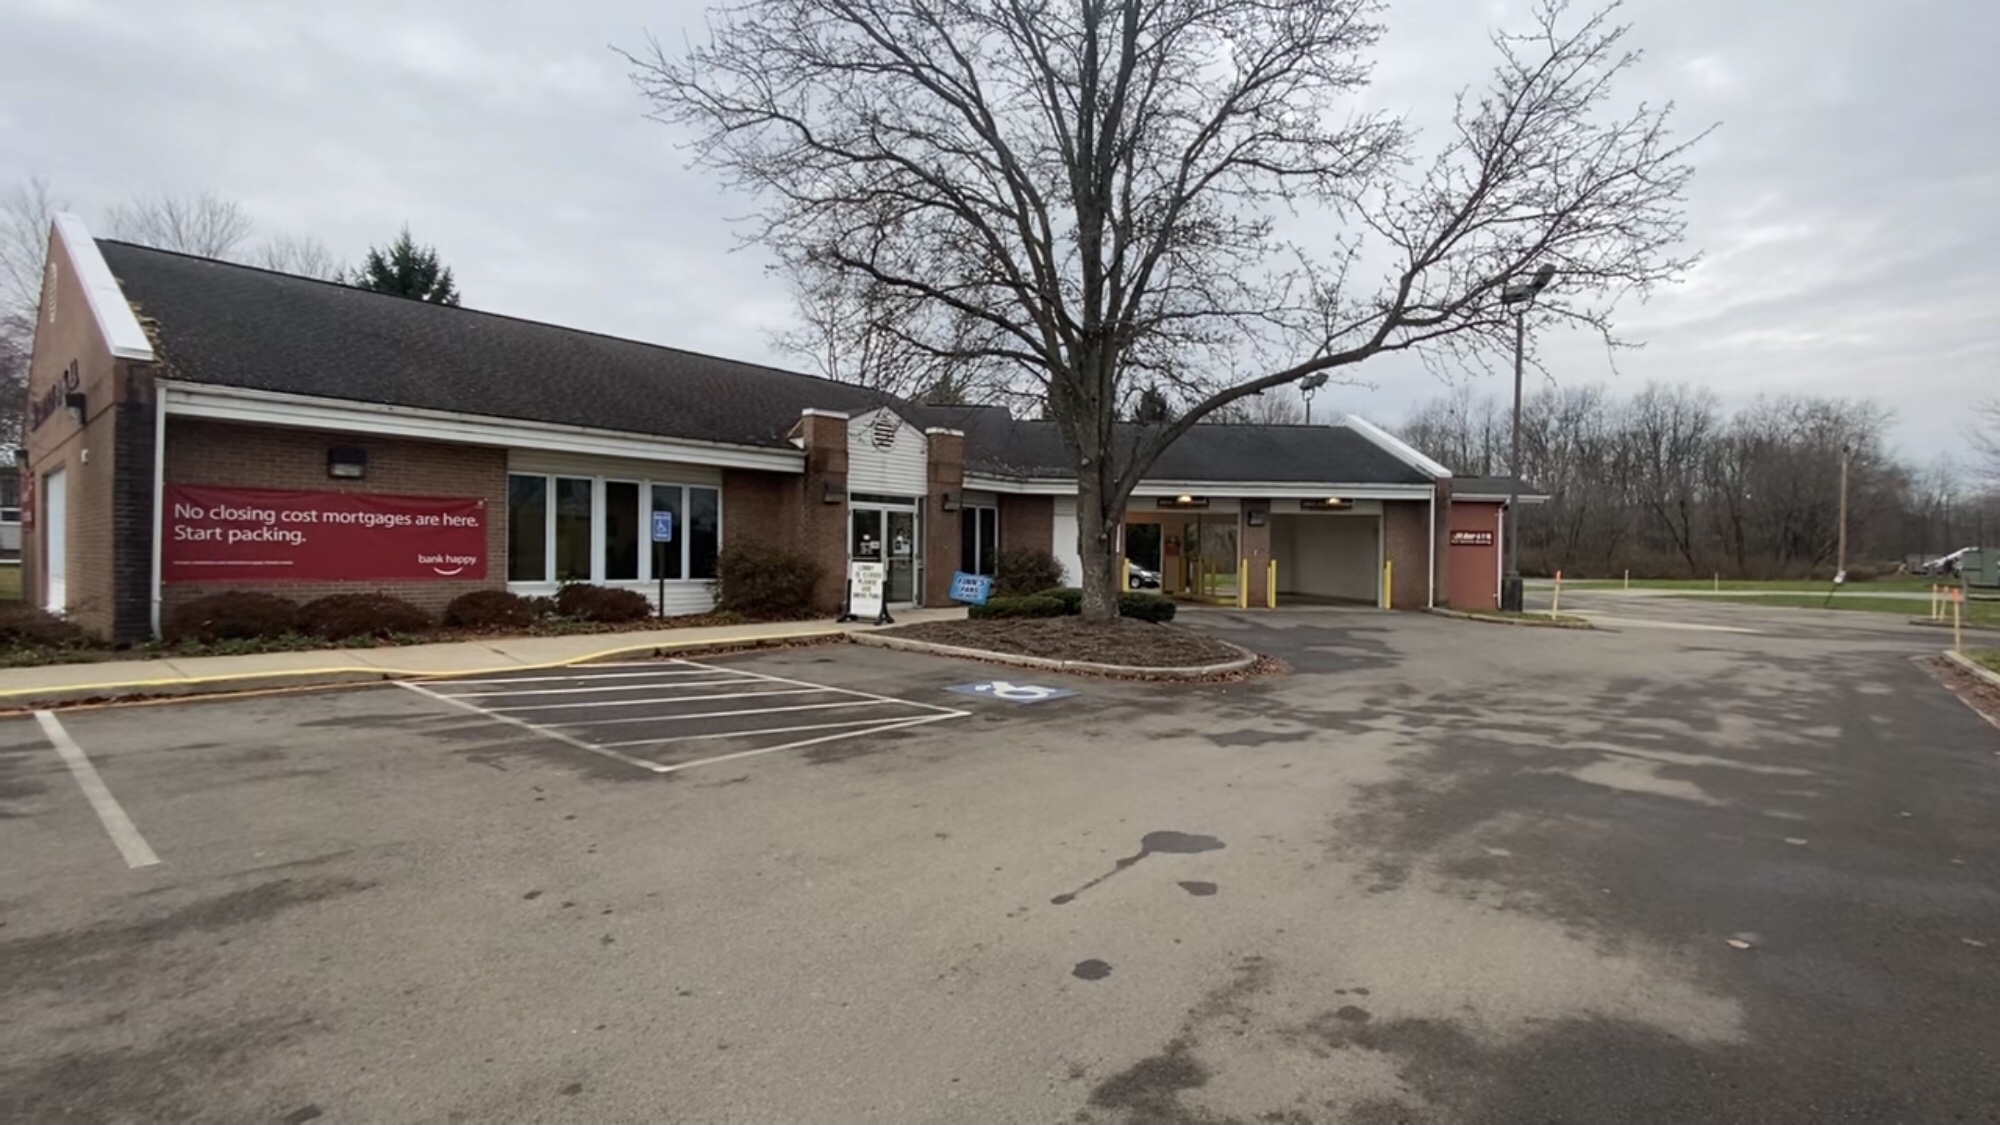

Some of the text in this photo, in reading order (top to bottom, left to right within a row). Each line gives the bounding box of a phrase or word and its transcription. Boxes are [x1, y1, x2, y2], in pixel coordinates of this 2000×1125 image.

[174, 503, 479, 528] No closing cost mortgages are here.
[174, 525, 307, 545] Start packing.
[418, 553, 477, 566] bank happy
